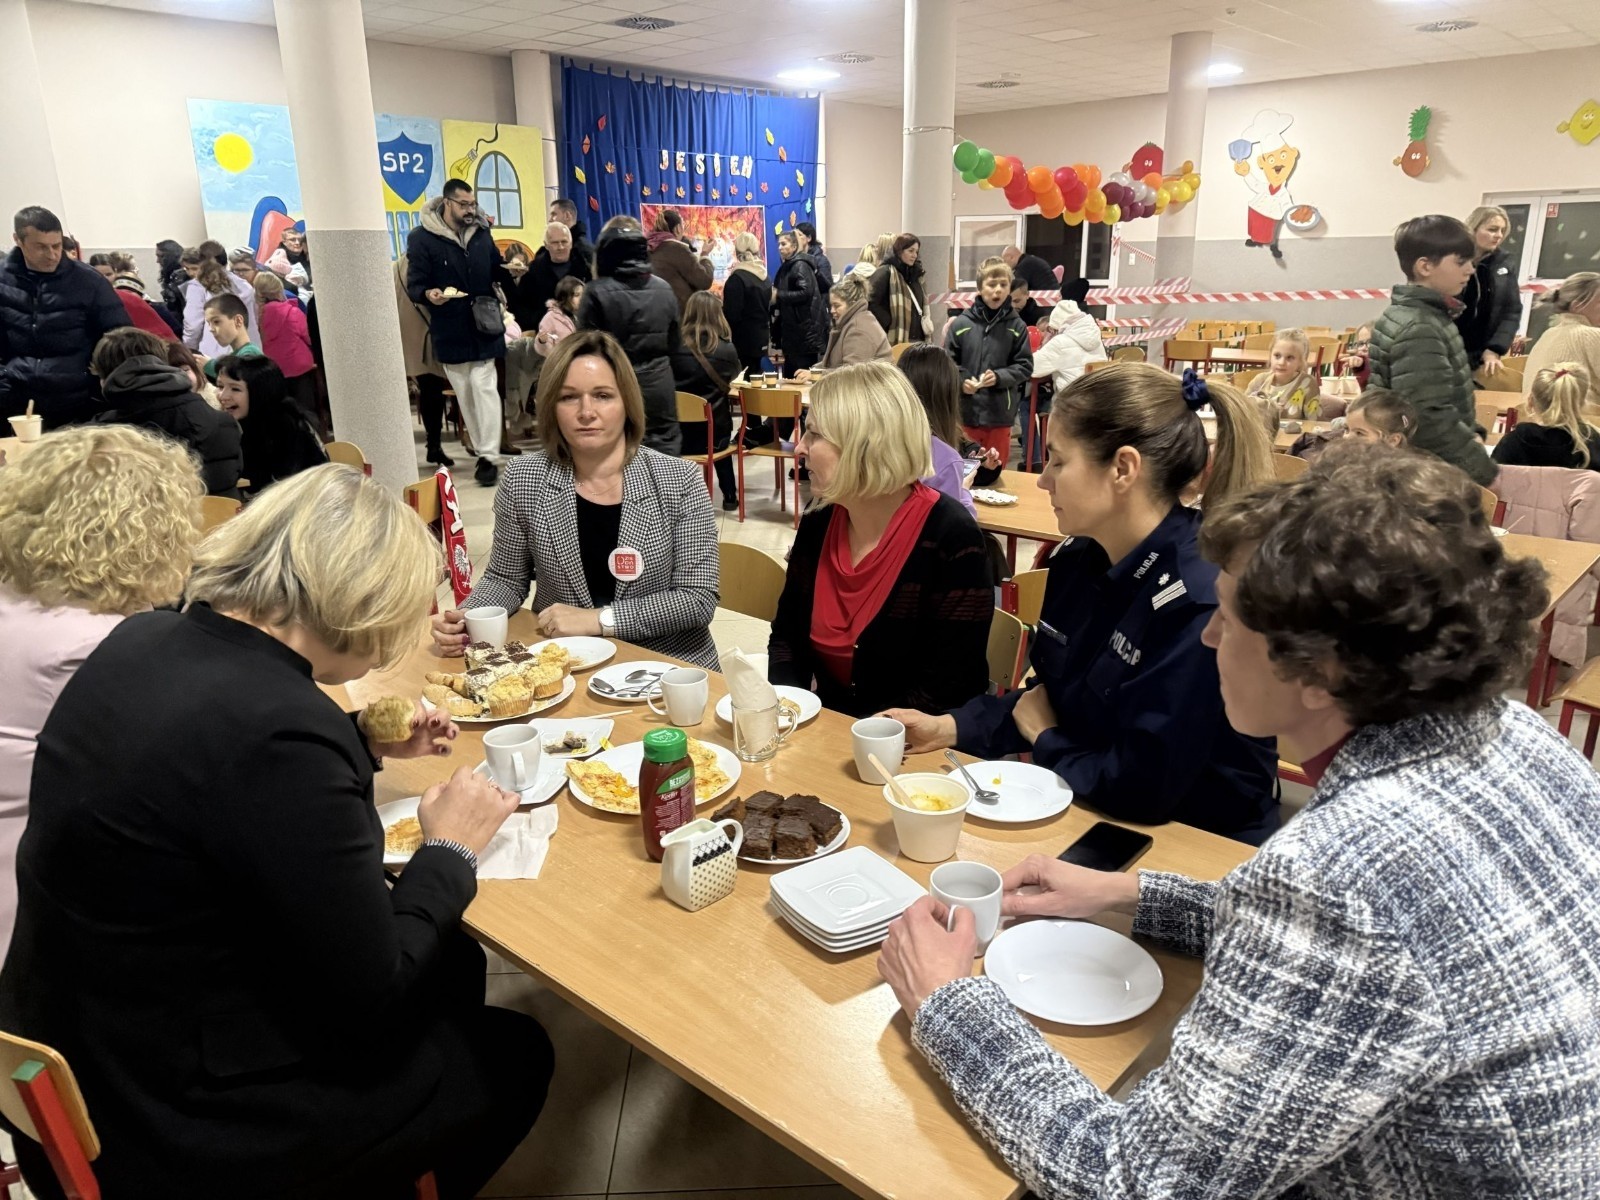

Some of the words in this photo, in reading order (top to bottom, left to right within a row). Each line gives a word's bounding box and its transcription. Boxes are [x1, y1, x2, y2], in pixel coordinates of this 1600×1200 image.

[382, 152, 425, 173] SP2
[1133, 551, 1160, 579] POLICJA
[1108, 629, 1141, 666] POLCJA
